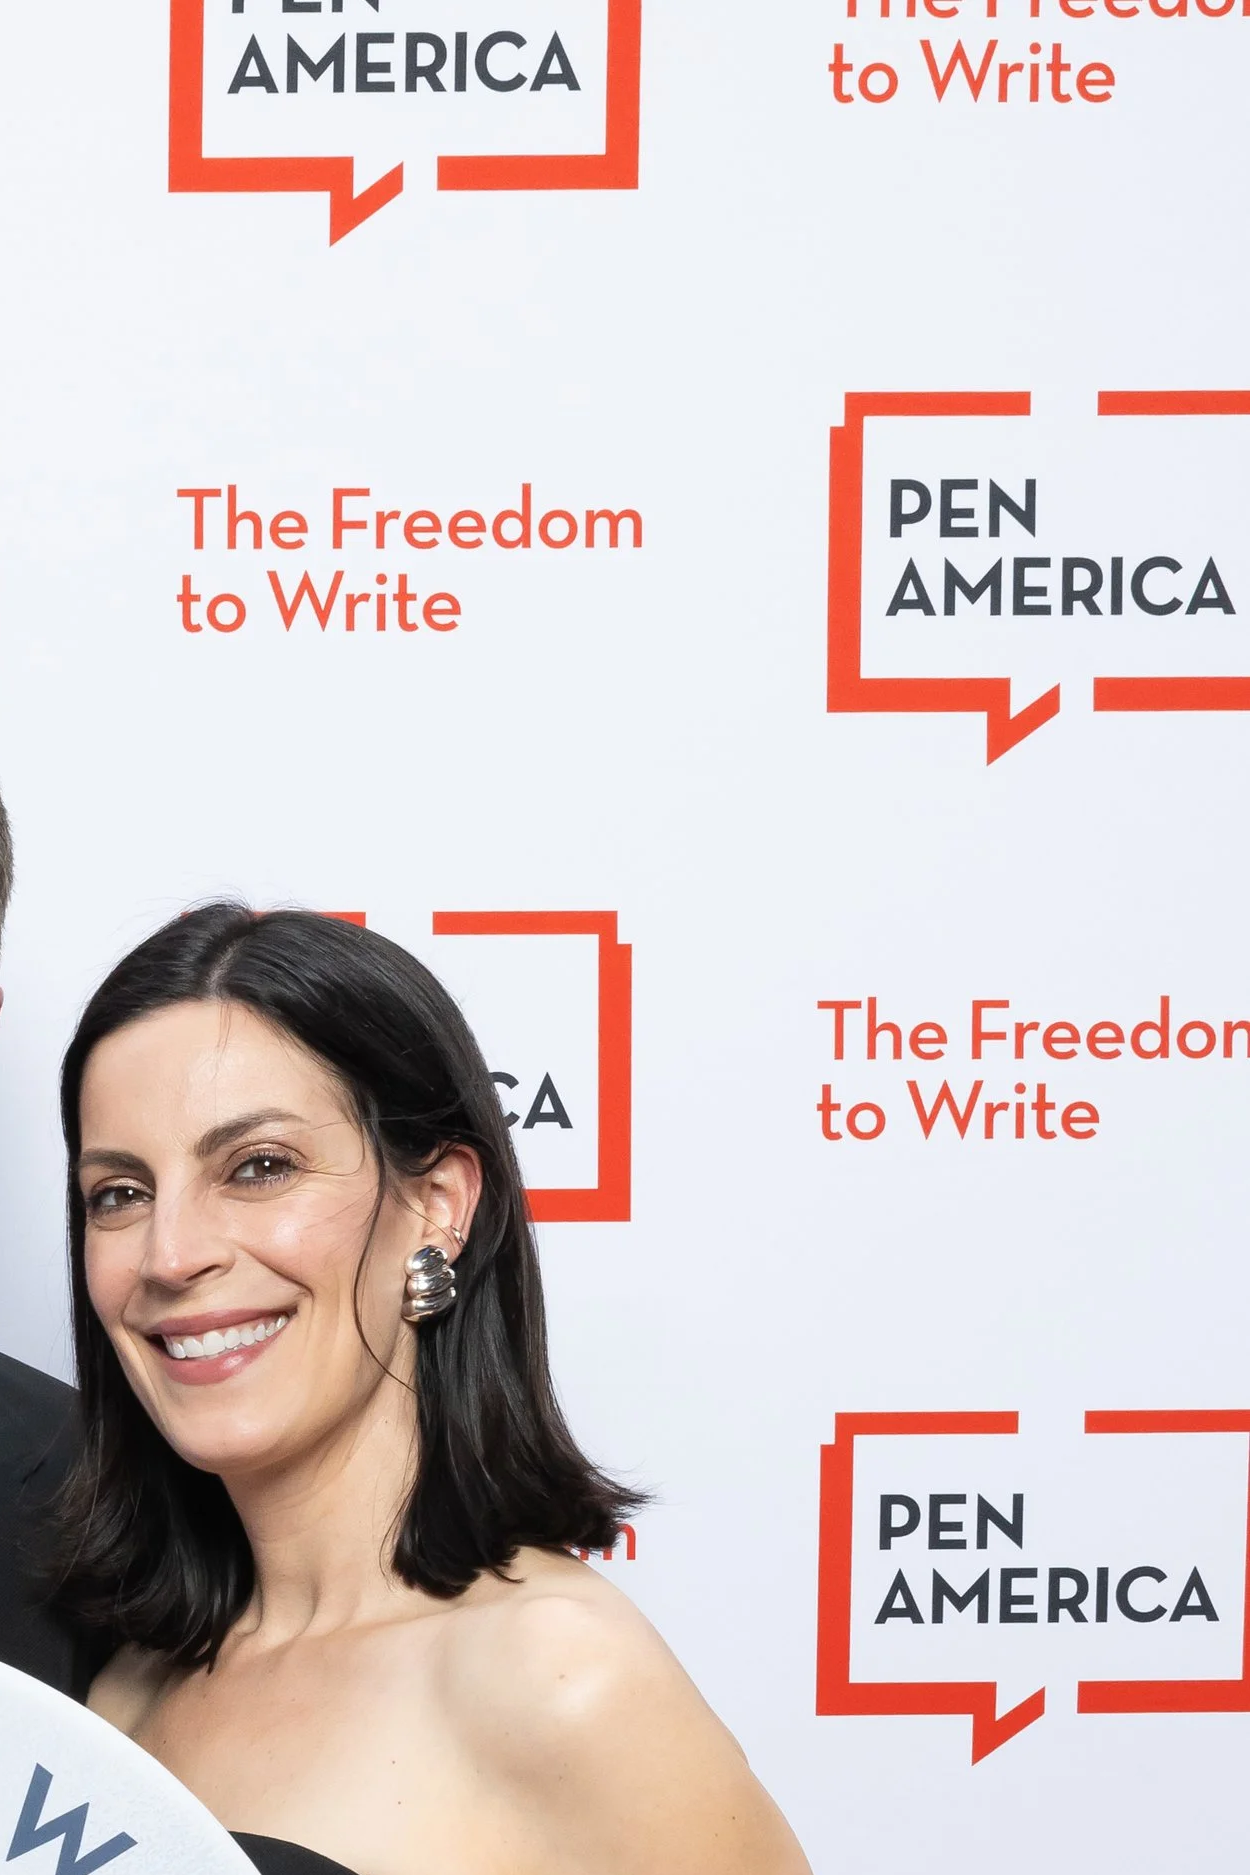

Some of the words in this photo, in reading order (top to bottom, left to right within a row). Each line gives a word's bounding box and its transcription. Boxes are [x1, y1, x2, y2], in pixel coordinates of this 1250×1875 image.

[228, 31, 580, 93] AMERICA
[828, 43, 898, 104] to
[921, 39, 1115, 103] Write
[177, 485, 308, 550] The
[333, 483, 642, 549] Freedom
[890, 479, 1036, 537] PEN
[177, 575, 246, 633] to
[268, 570, 461, 632] Write
[886, 557, 1236, 616] AMERICA
[817, 997, 948, 1060] The
[817, 1084, 886, 1140] to
[907, 1080, 1099, 1140] Write
[880, 1494, 1023, 1550] PEN
[875, 1566, 1219, 1624] AMERICA
